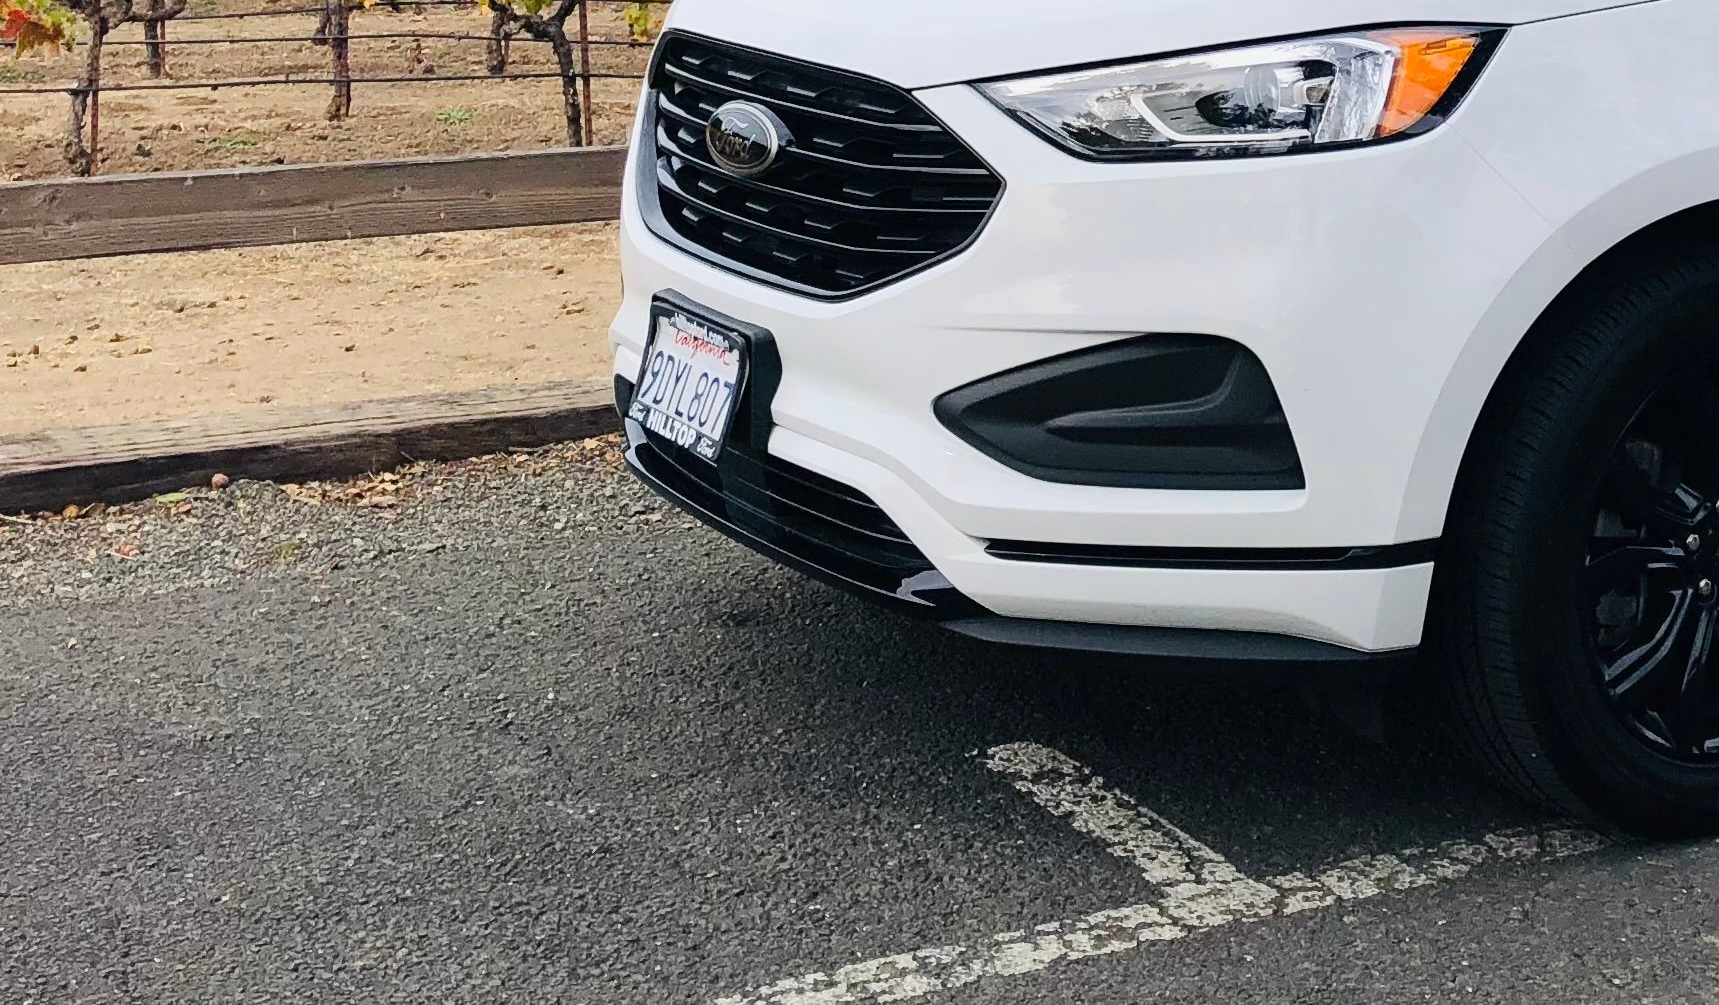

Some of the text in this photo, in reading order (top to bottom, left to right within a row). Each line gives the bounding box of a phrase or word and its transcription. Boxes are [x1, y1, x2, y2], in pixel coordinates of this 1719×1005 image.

[716, 116, 757, 159] Ford
[628, 401, 647, 422] Ford
[640, 350, 736, 435] 9DYL807
[645, 408, 697, 449] HILLTOP
[696, 437, 716, 459] Ford
